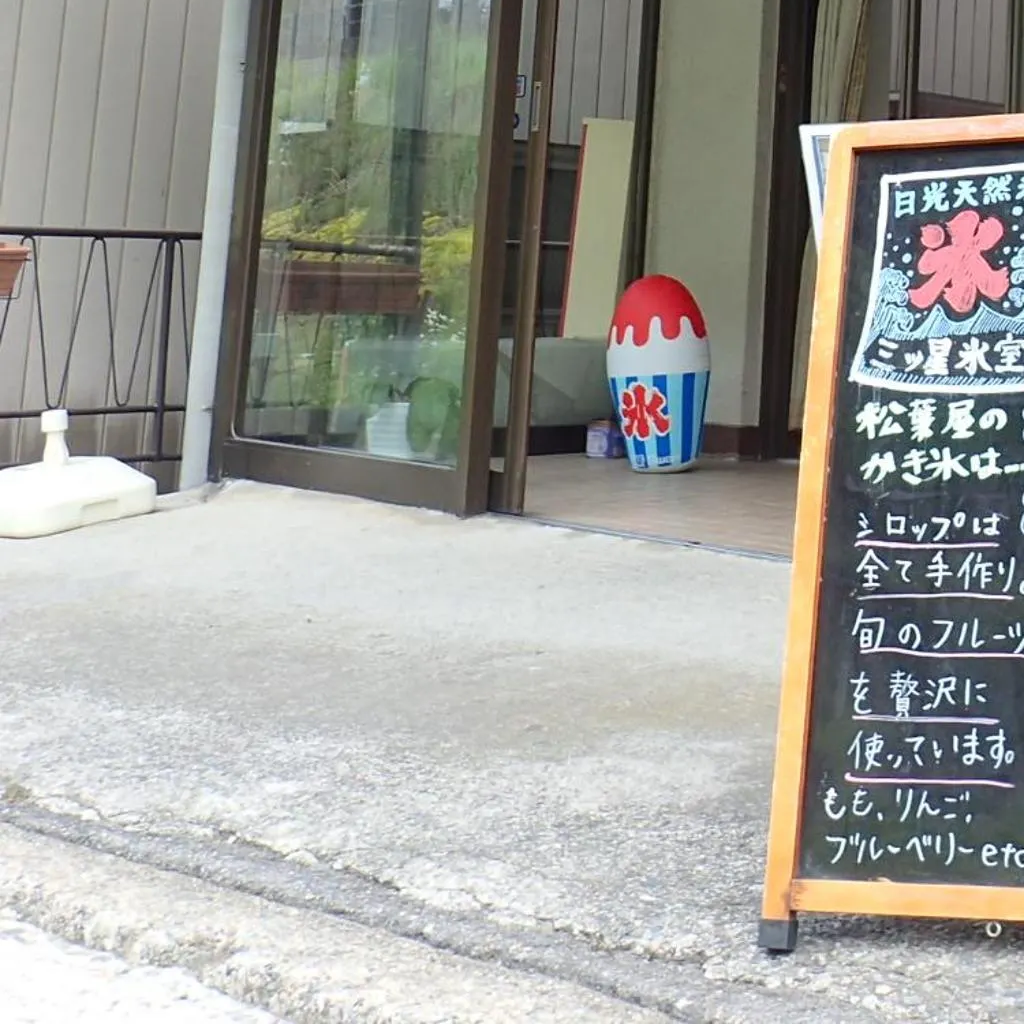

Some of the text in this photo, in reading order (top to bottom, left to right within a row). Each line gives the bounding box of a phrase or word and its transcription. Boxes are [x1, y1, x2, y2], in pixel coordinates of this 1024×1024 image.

[908, 209, 1009, 313] 氷
[621, 382, 671, 441] 氷
[856, 398, 1008, 439] 松葉屋の
[856, 514, 1000, 541] シロップは
[851, 670, 988, 718] を贅沢に
[847, 729, 1015, 769] 使っています。
